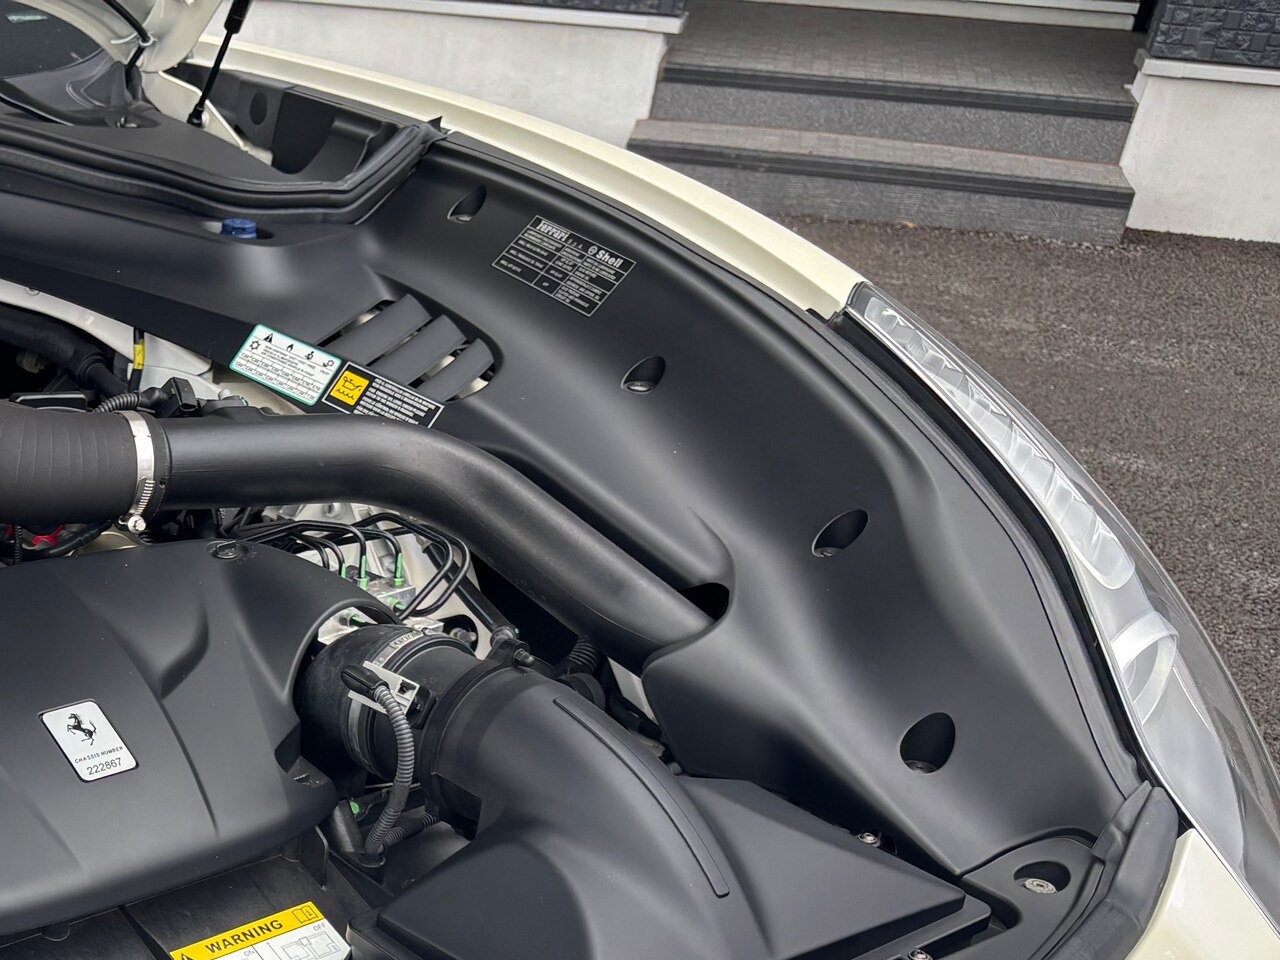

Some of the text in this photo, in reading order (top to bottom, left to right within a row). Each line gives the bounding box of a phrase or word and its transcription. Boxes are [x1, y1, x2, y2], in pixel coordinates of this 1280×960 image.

[536, 220, 570, 242] Ferrari
[595, 250, 624, 268] Shell
[74, 746, 124, 764] CHASSIS NUMBER
[86, 757, 122, 776] 222867
[313, 922, 326, 932] OFF
[205, 919, 283, 954] WARNING
[244, 949, 256, 958] ON
